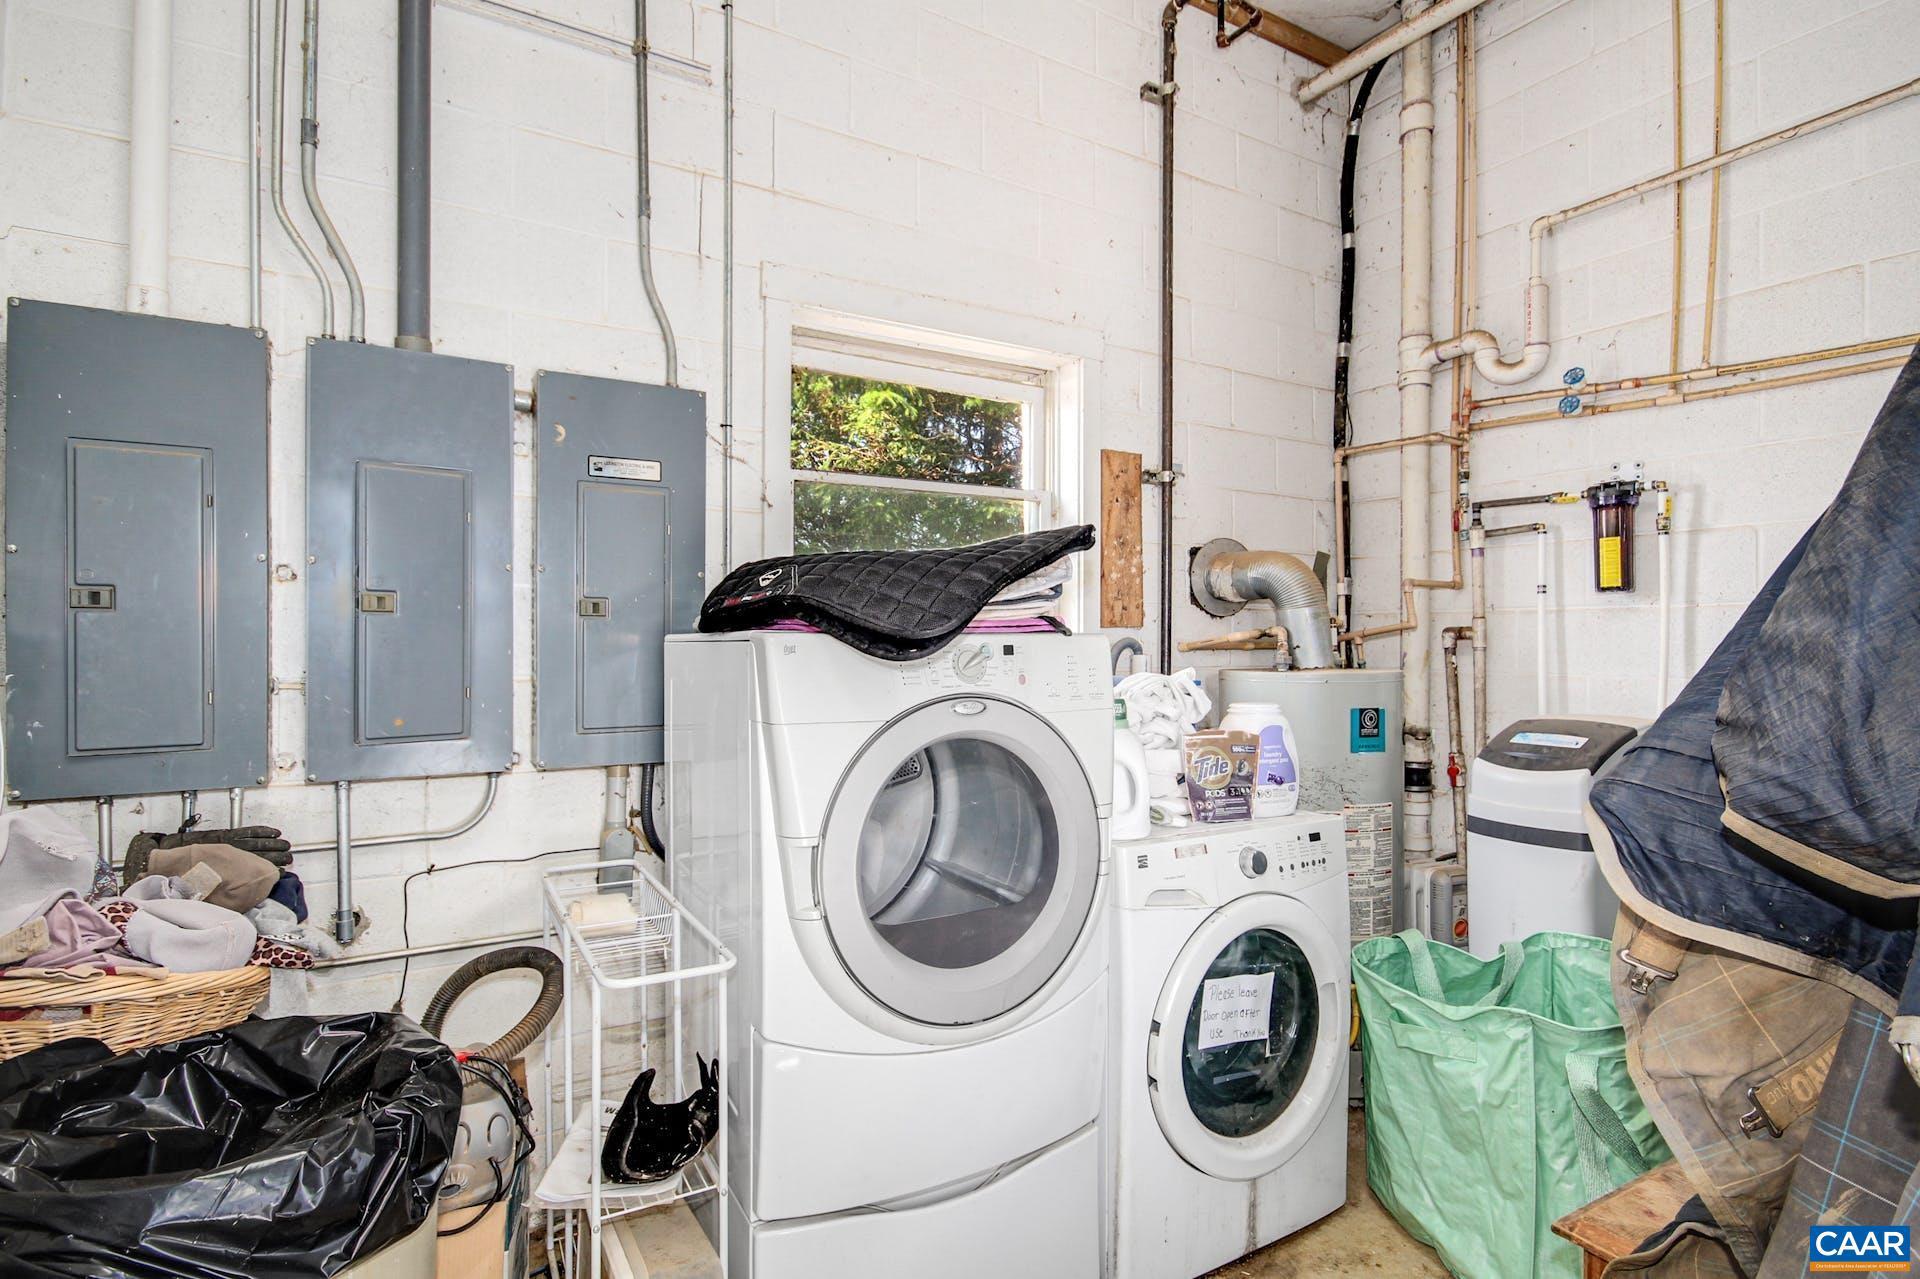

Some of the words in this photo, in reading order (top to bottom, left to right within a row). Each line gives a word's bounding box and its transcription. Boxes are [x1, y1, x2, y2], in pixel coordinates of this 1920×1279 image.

[1193, 756, 1230, 785] Tide
[1205, 789, 1226, 798] PODS
[1210, 984, 1235, 1000] Please
[1239, 985, 1258, 997] leave
